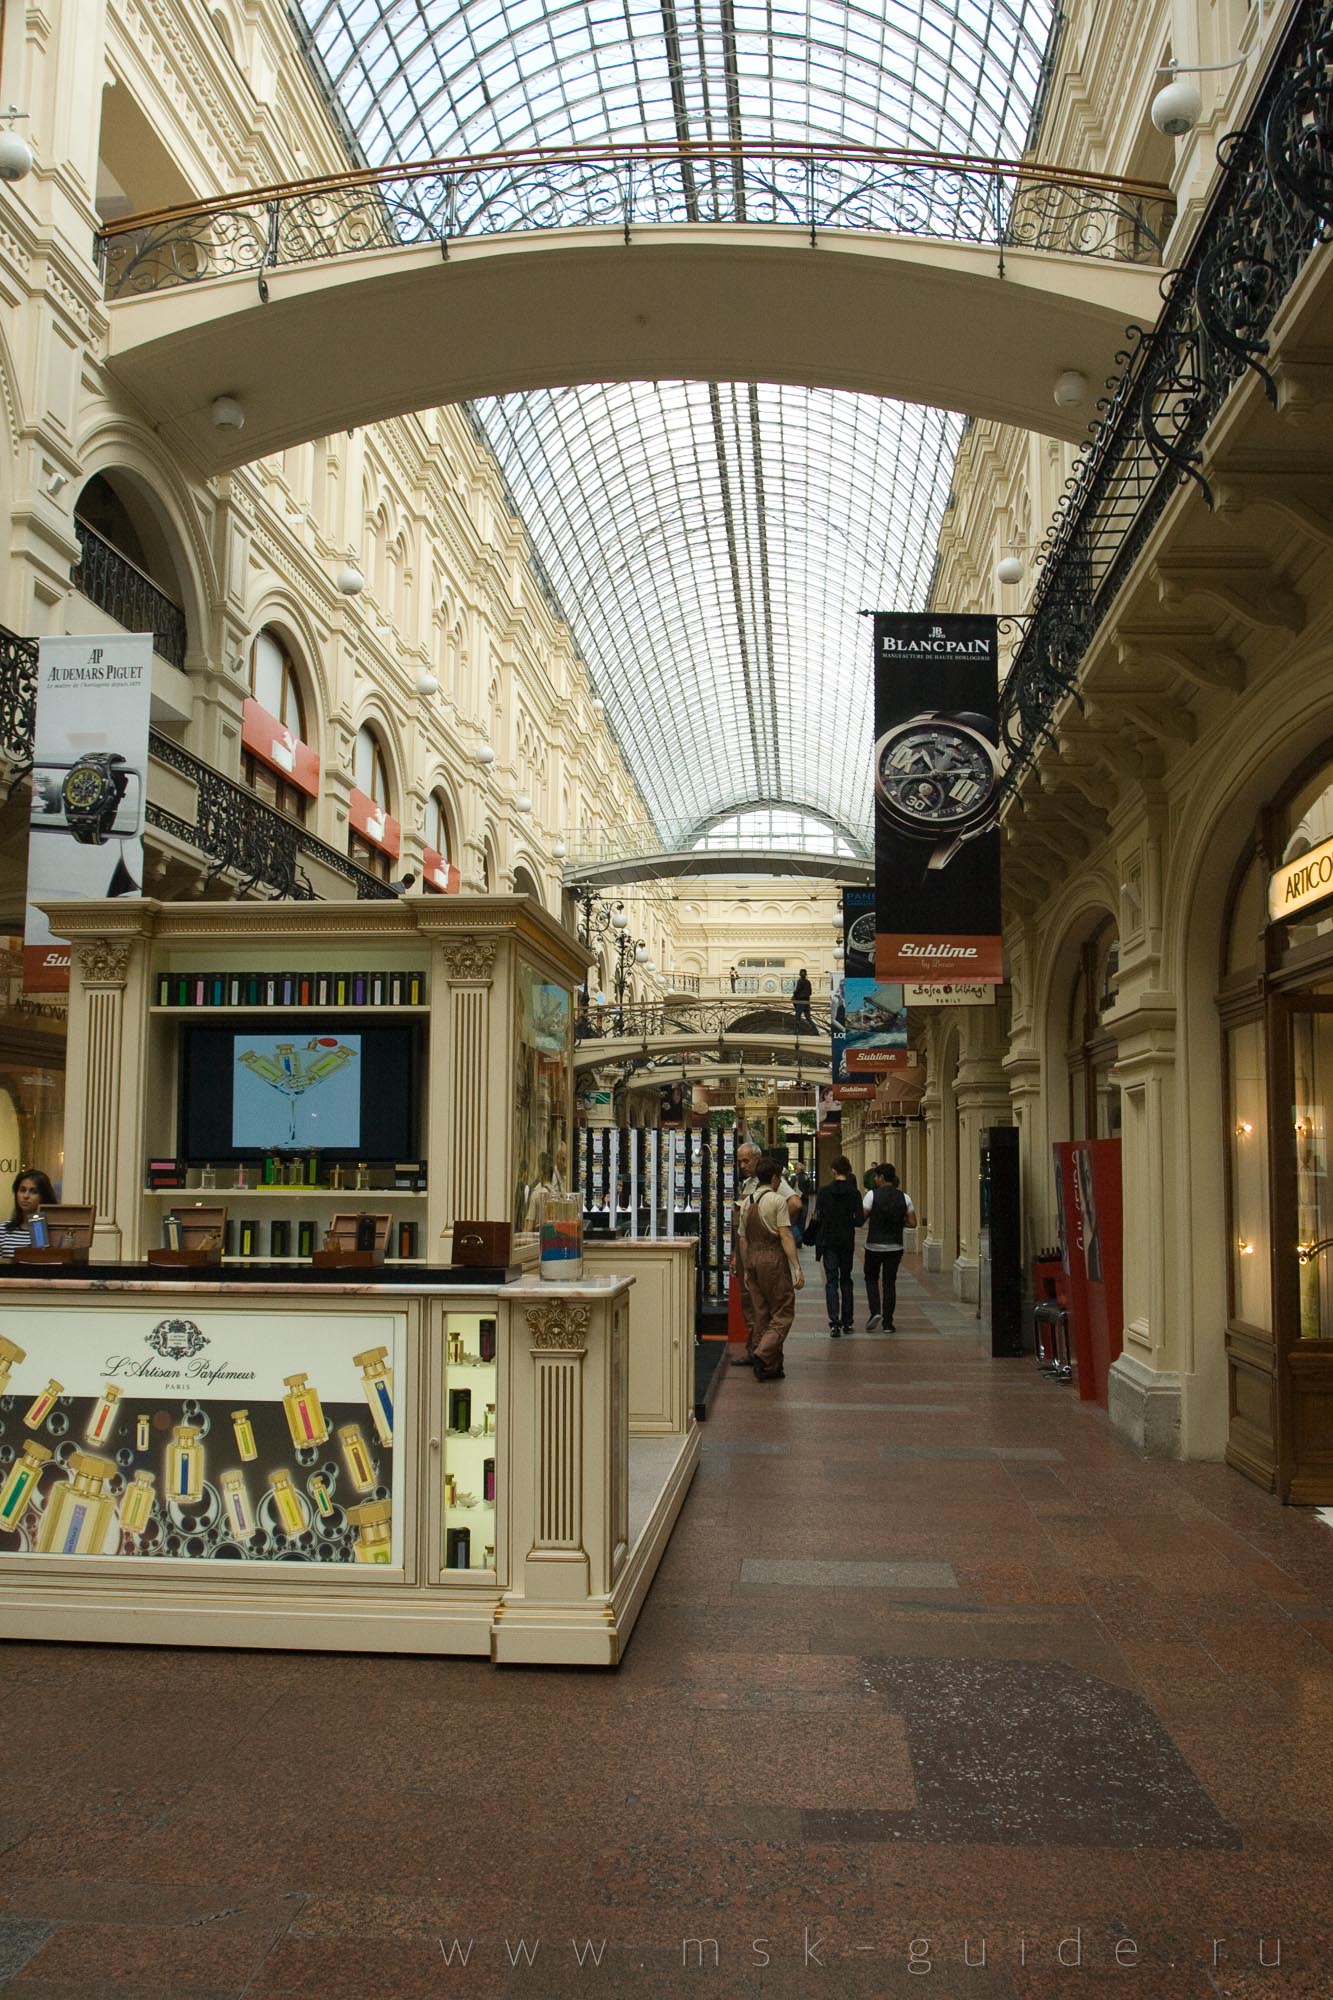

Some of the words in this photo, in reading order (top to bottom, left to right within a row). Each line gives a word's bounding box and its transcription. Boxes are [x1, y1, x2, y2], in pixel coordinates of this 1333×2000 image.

[882, 636, 991, 653] BLANCPAIN
[47, 666, 104, 682] AUDEMARS
[105, 664, 144, 680] PIGUET
[897, 943, 979, 958] Sublime
[856, 1053, 897, 1061] Sublime
[99, 1355, 181, 1377] L'Artisan
[184, 1357, 256, 1386] Parfumeur
